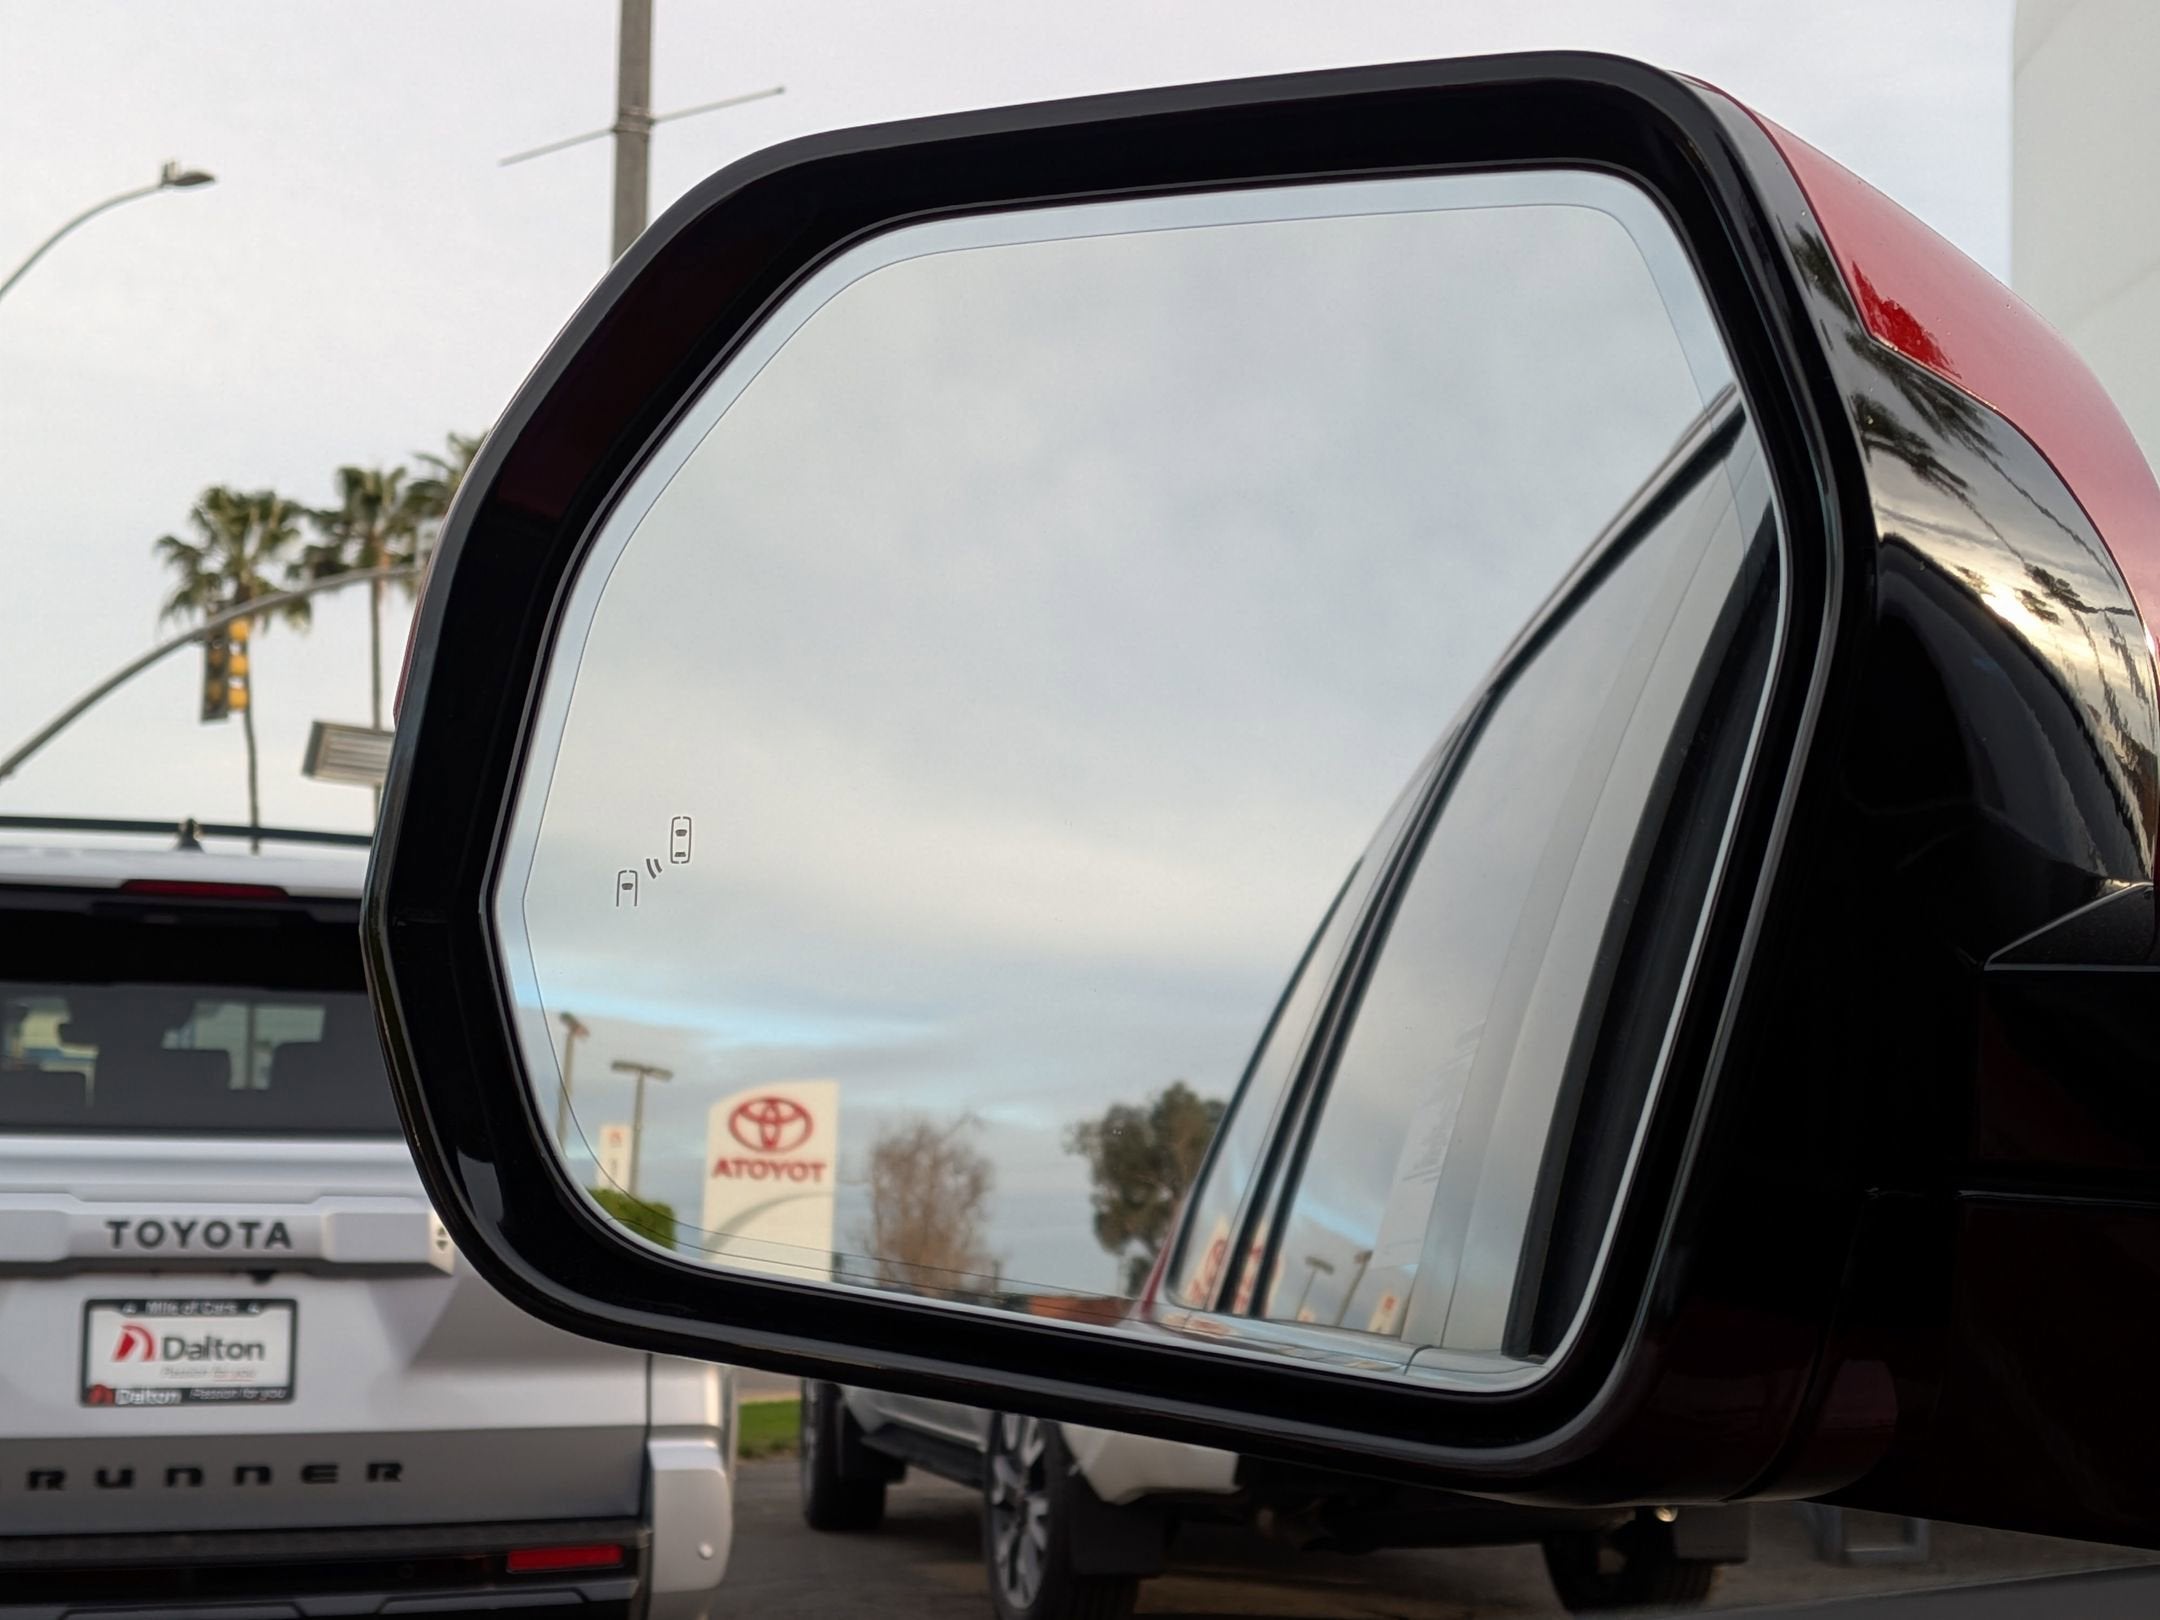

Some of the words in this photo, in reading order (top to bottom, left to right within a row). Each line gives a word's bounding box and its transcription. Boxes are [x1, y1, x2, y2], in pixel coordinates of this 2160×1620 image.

[106, 1220, 292, 1249] TOYOTA
[162, 1335, 265, 1361] Dalton
[116, 1388, 181, 1405] Dalton
